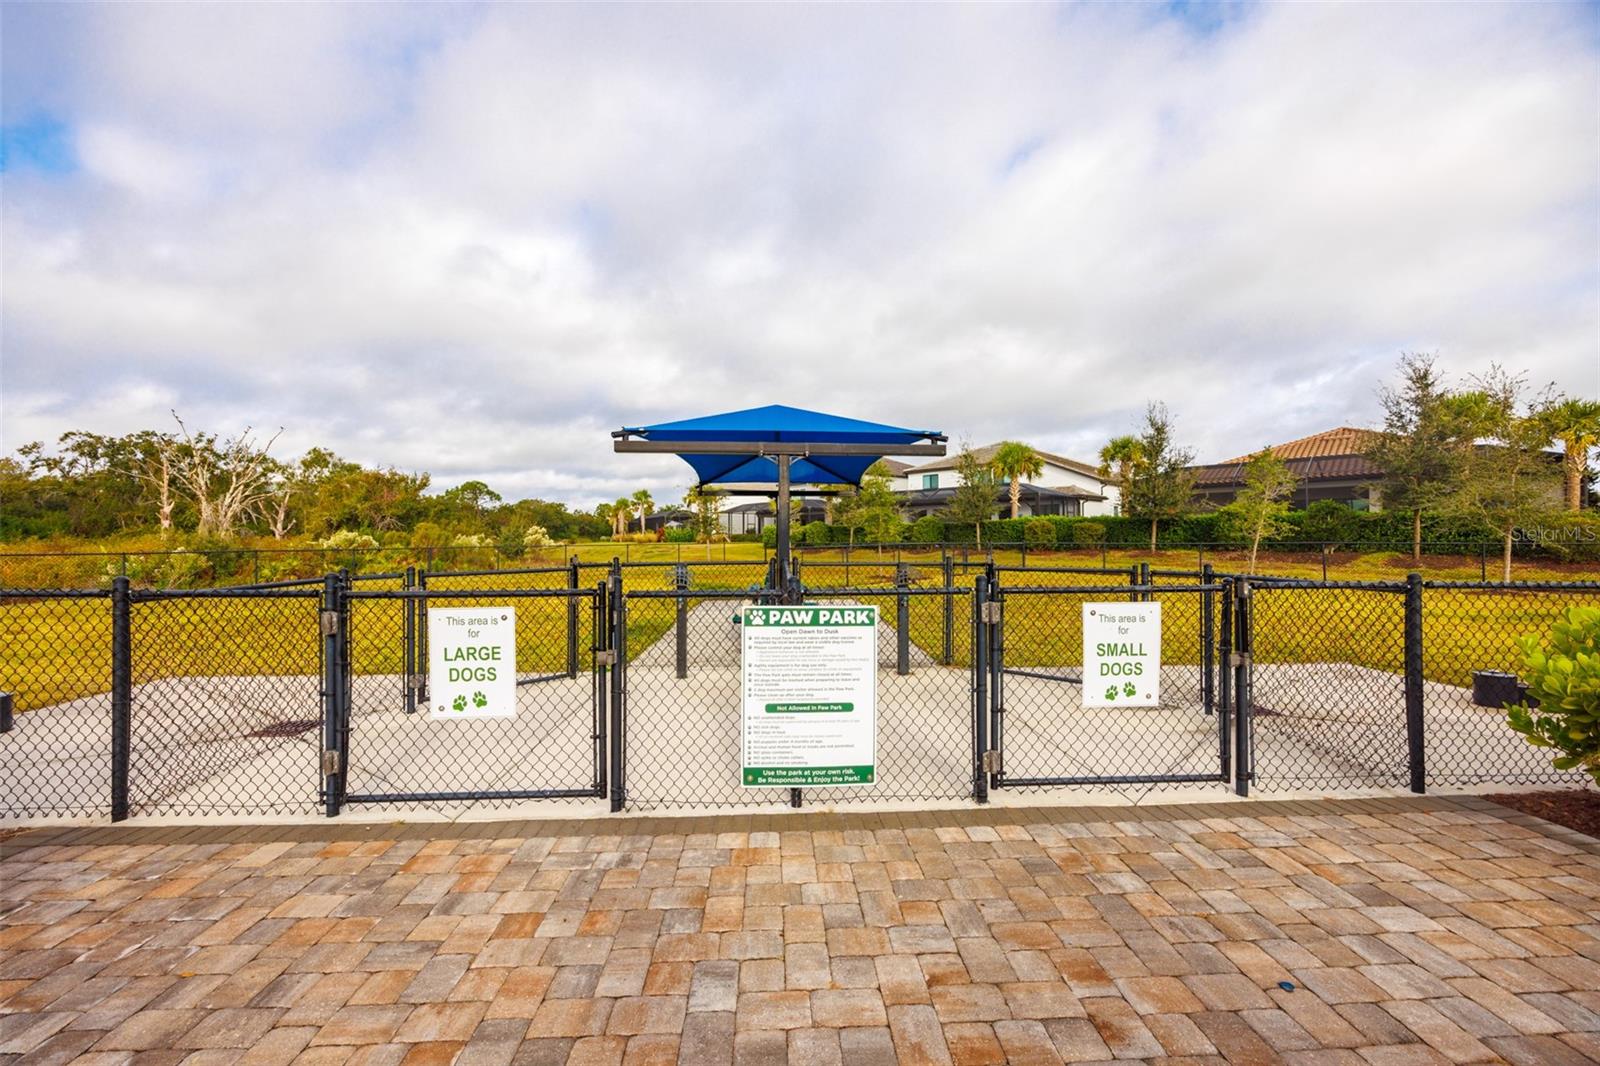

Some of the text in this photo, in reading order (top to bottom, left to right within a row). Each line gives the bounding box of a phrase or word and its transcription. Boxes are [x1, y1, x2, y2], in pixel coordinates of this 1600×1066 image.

[446, 616, 466, 626] This
[491, 616, 498, 625] is
[770, 610, 870, 624] PAW PARK
[1099, 614, 1116, 623] This
[1139, 614, 1146, 622] is
[468, 628, 480, 638] for
[1118, 626, 1129, 634] for
[444, 646, 502, 661] LARGE
[1096, 643, 1148, 656] SMALL
[449, 667, 497, 682] DOGS
[1100, 662, 1143, 676] DOGS
